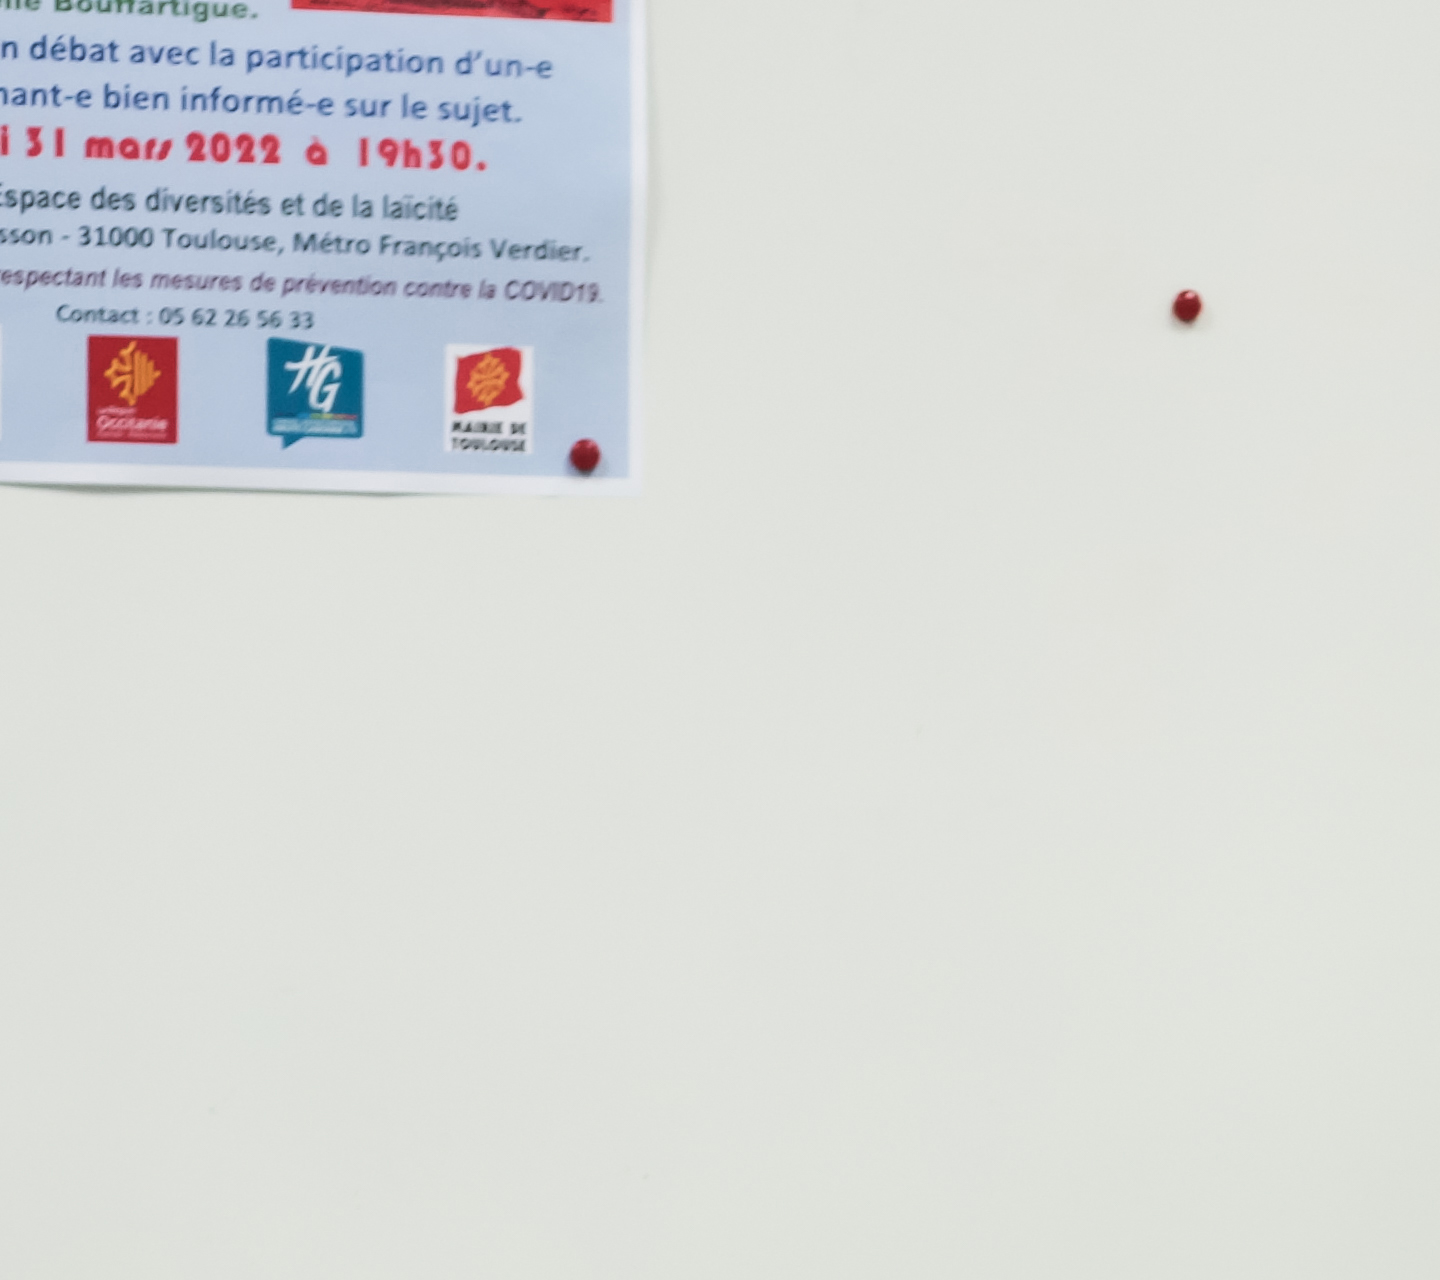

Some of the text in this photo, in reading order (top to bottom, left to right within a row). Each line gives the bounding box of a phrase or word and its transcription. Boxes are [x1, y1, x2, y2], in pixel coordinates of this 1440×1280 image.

[30, 34, 119, 64] débat
[129, 42, 199, 66] avec
[210, 40, 235, 68] la
[246, 44, 444, 77] participation
[103, 83, 169, 111] bien
[181, 85, 334, 116] informé-e
[344, 98, 391, 118] sur
[402, 93, 428, 119] le
[438, 97, 522, 127] sujet.
[26, 125, 65, 159] 31
[84, 134, 173, 161] mars
[185, 132, 281, 165] 2022
[305, 136, 329, 166] à
[359, 137, 487, 172] 19h30.
[90, 186, 136, 212] des
[145, 187, 270, 217] diversités
[281, 191, 305, 217] et
[313, 190, 343, 217] de
[352, 192, 374, 219] la
[383, 191, 459, 222] laïcité
[78, 225, 153, 249] 31000
[161, 227, 284, 256] Toulouse,
[293, 231, 370, 256] Métro
[379, 235, 482, 262] François
[490, 238, 590, 263] Verdier.
[112, 266, 142, 289] les
[150, 273, 242, 292] mesures
[250, 272, 276, 294] de
[282, 273, 398, 298] prévention
[403, 279, 472, 299] contre
[479, 279, 495, 300] la
[56, 305, 139, 325] Contact
[159, 307, 185, 325] 05
[192, 308, 217, 325] 62
[224, 309, 250, 328] 26
[257, 310, 283, 328] 56
[289, 311, 314, 329] 33
